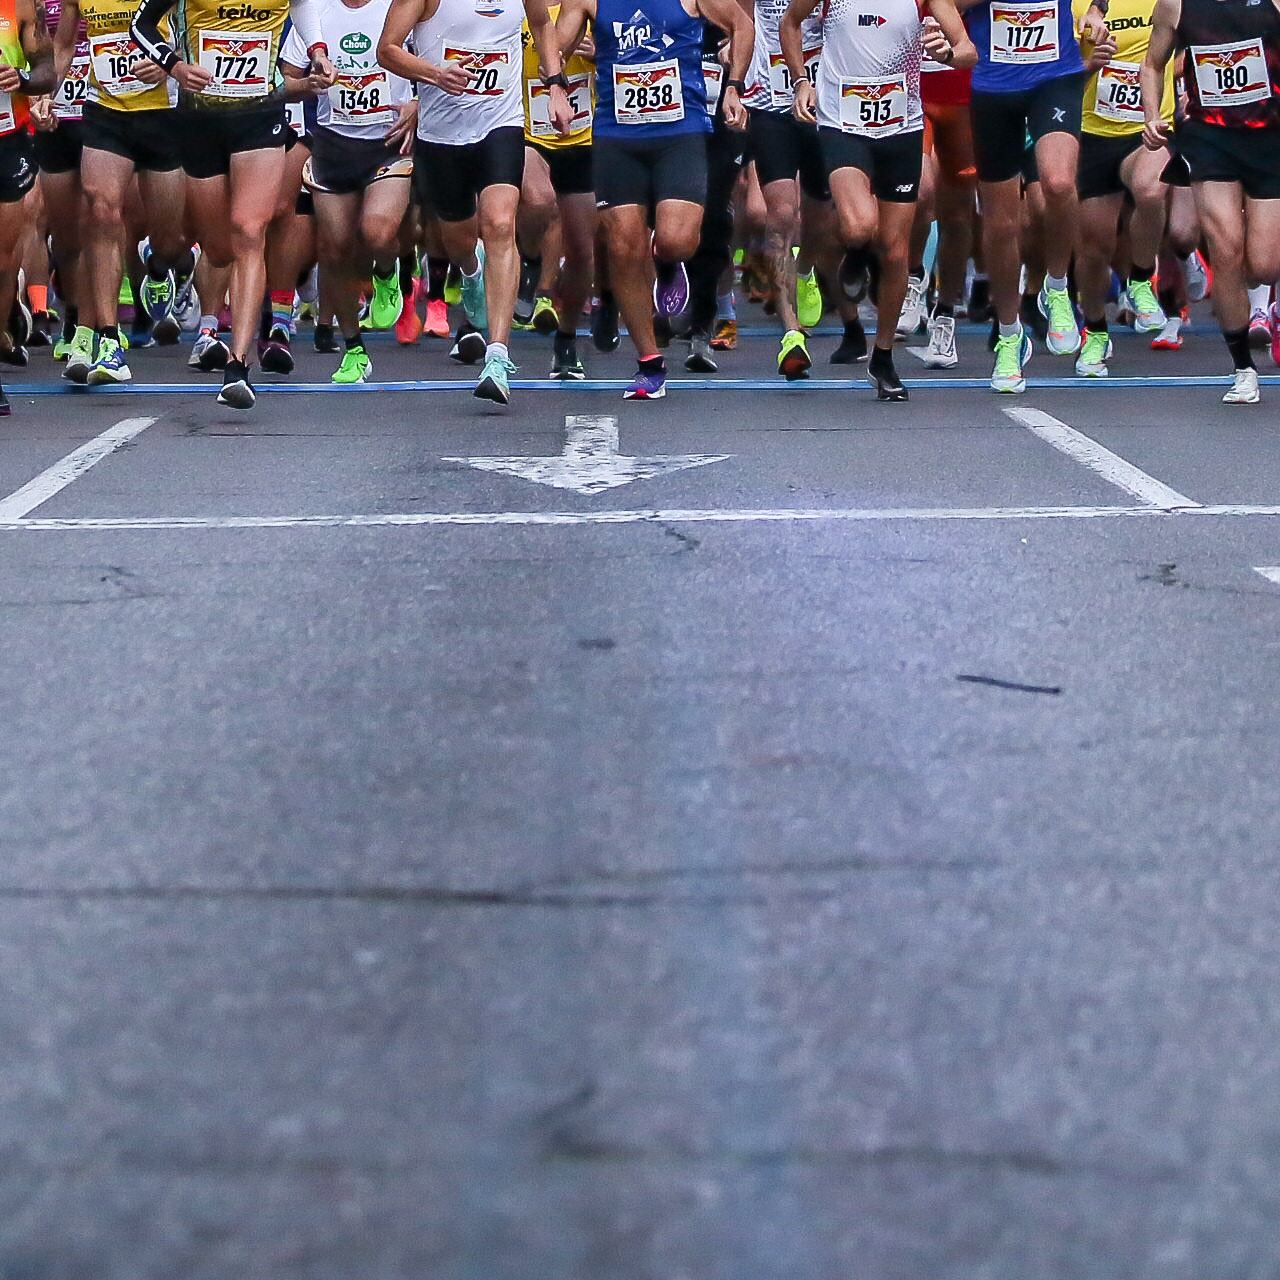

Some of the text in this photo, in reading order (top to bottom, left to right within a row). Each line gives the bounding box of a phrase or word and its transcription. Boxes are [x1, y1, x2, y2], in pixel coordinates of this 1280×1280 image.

[217, 3, 272, 21] teika
[1006, 25, 1045, 48] 1177
[214, 56, 258, 79] 1772
[1214, 65, 1248, 90] 180
[339, 88, 380, 109] 1348
[624, 84, 673, 108] 2838
[1108, 83, 1142, 104] 163
[859, 99, 892, 122] 513
